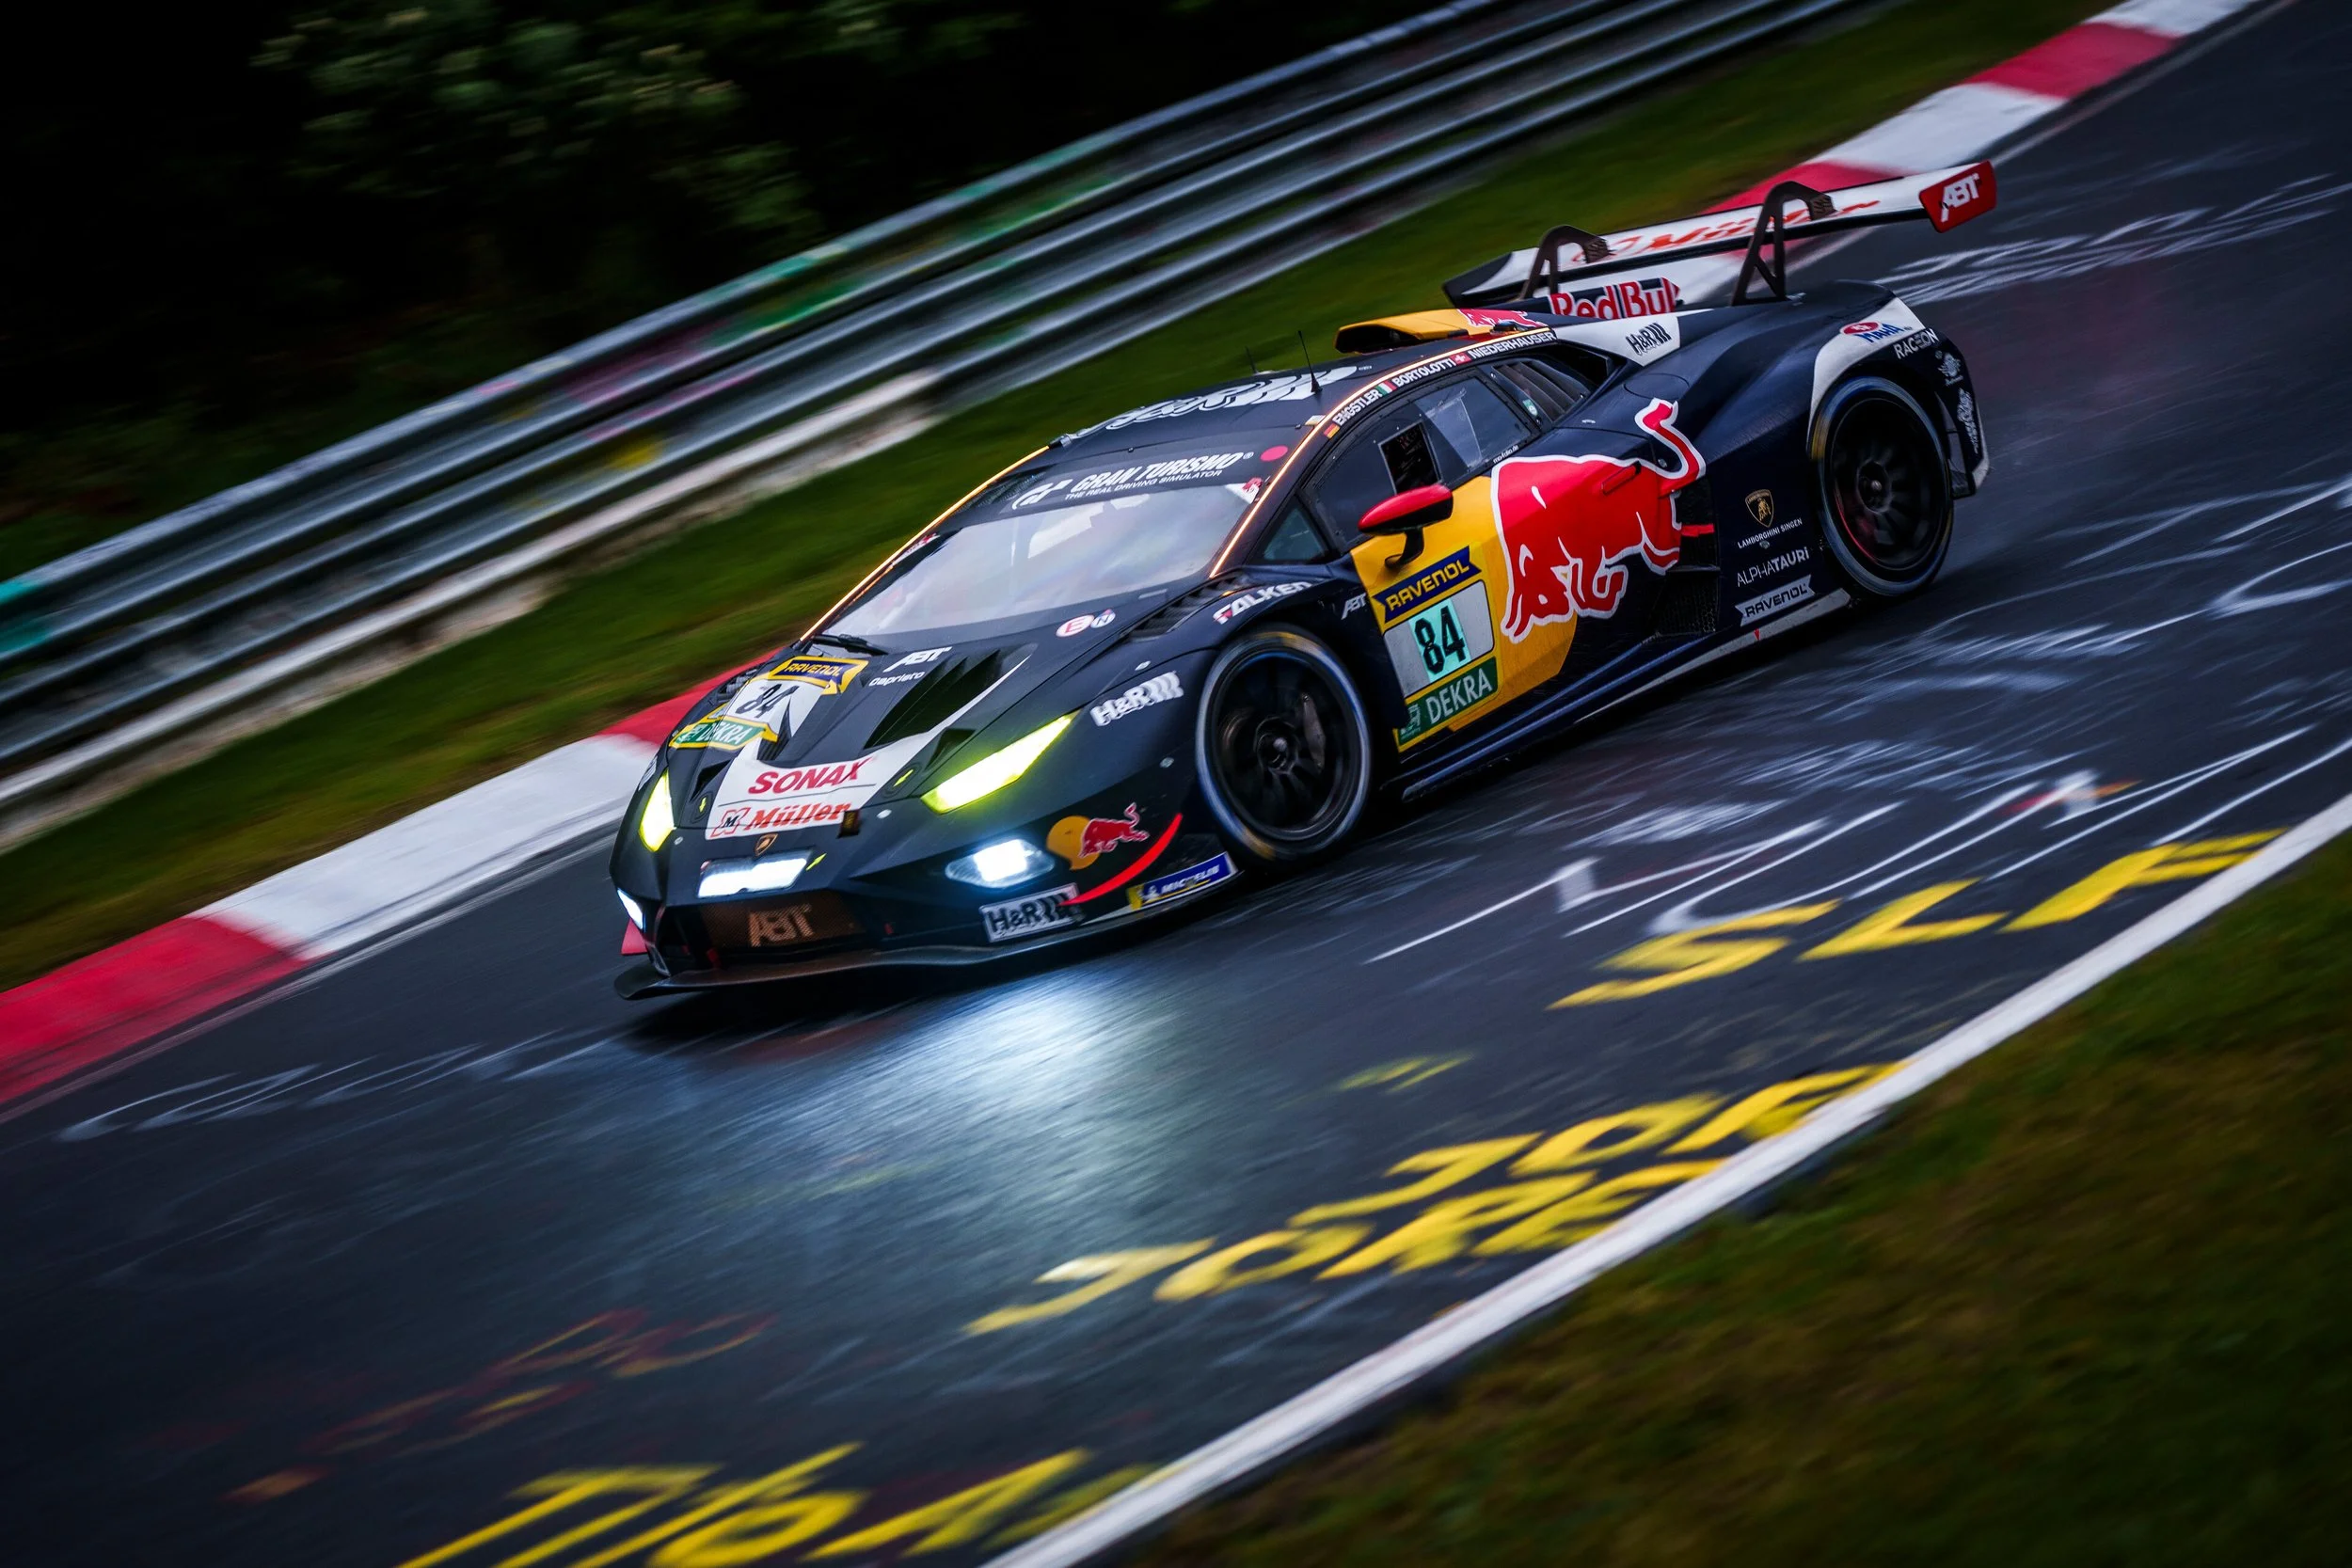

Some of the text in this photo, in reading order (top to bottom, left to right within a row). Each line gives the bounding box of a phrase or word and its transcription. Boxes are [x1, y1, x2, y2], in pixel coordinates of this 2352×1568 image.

[1940, 172, 1980, 223] ABT
[1549, 285, 1620, 321] Red
[1332, 332, 1557, 426] ENGSTLER BORTOLOTTI NIEDERHAUSER
[1064, 469, 1222, 500] THE REAL DRIVING SIMULATOR
[1071, 467, 1142, 493] GRAN
[1738, 517, 1803, 548] LAMBORGHINI SINGEN
[1385, 559, 1470, 611] RAVENOL
[1744, 584, 1808, 618] RAVENOL
[1341, 593, 1367, 620] ABT
[1414, 605, 1467, 675] 84
[784, 662, 843, 676] RAVENOL
[882, 646, 952, 673] ABT
[735, 684, 800, 719] 84
[1425, 668, 1493, 725] DEKRA
[748, 756, 874, 795] SONAX
[744, 802, 851, 831] Müller
[748, 903, 815, 948] ABT
